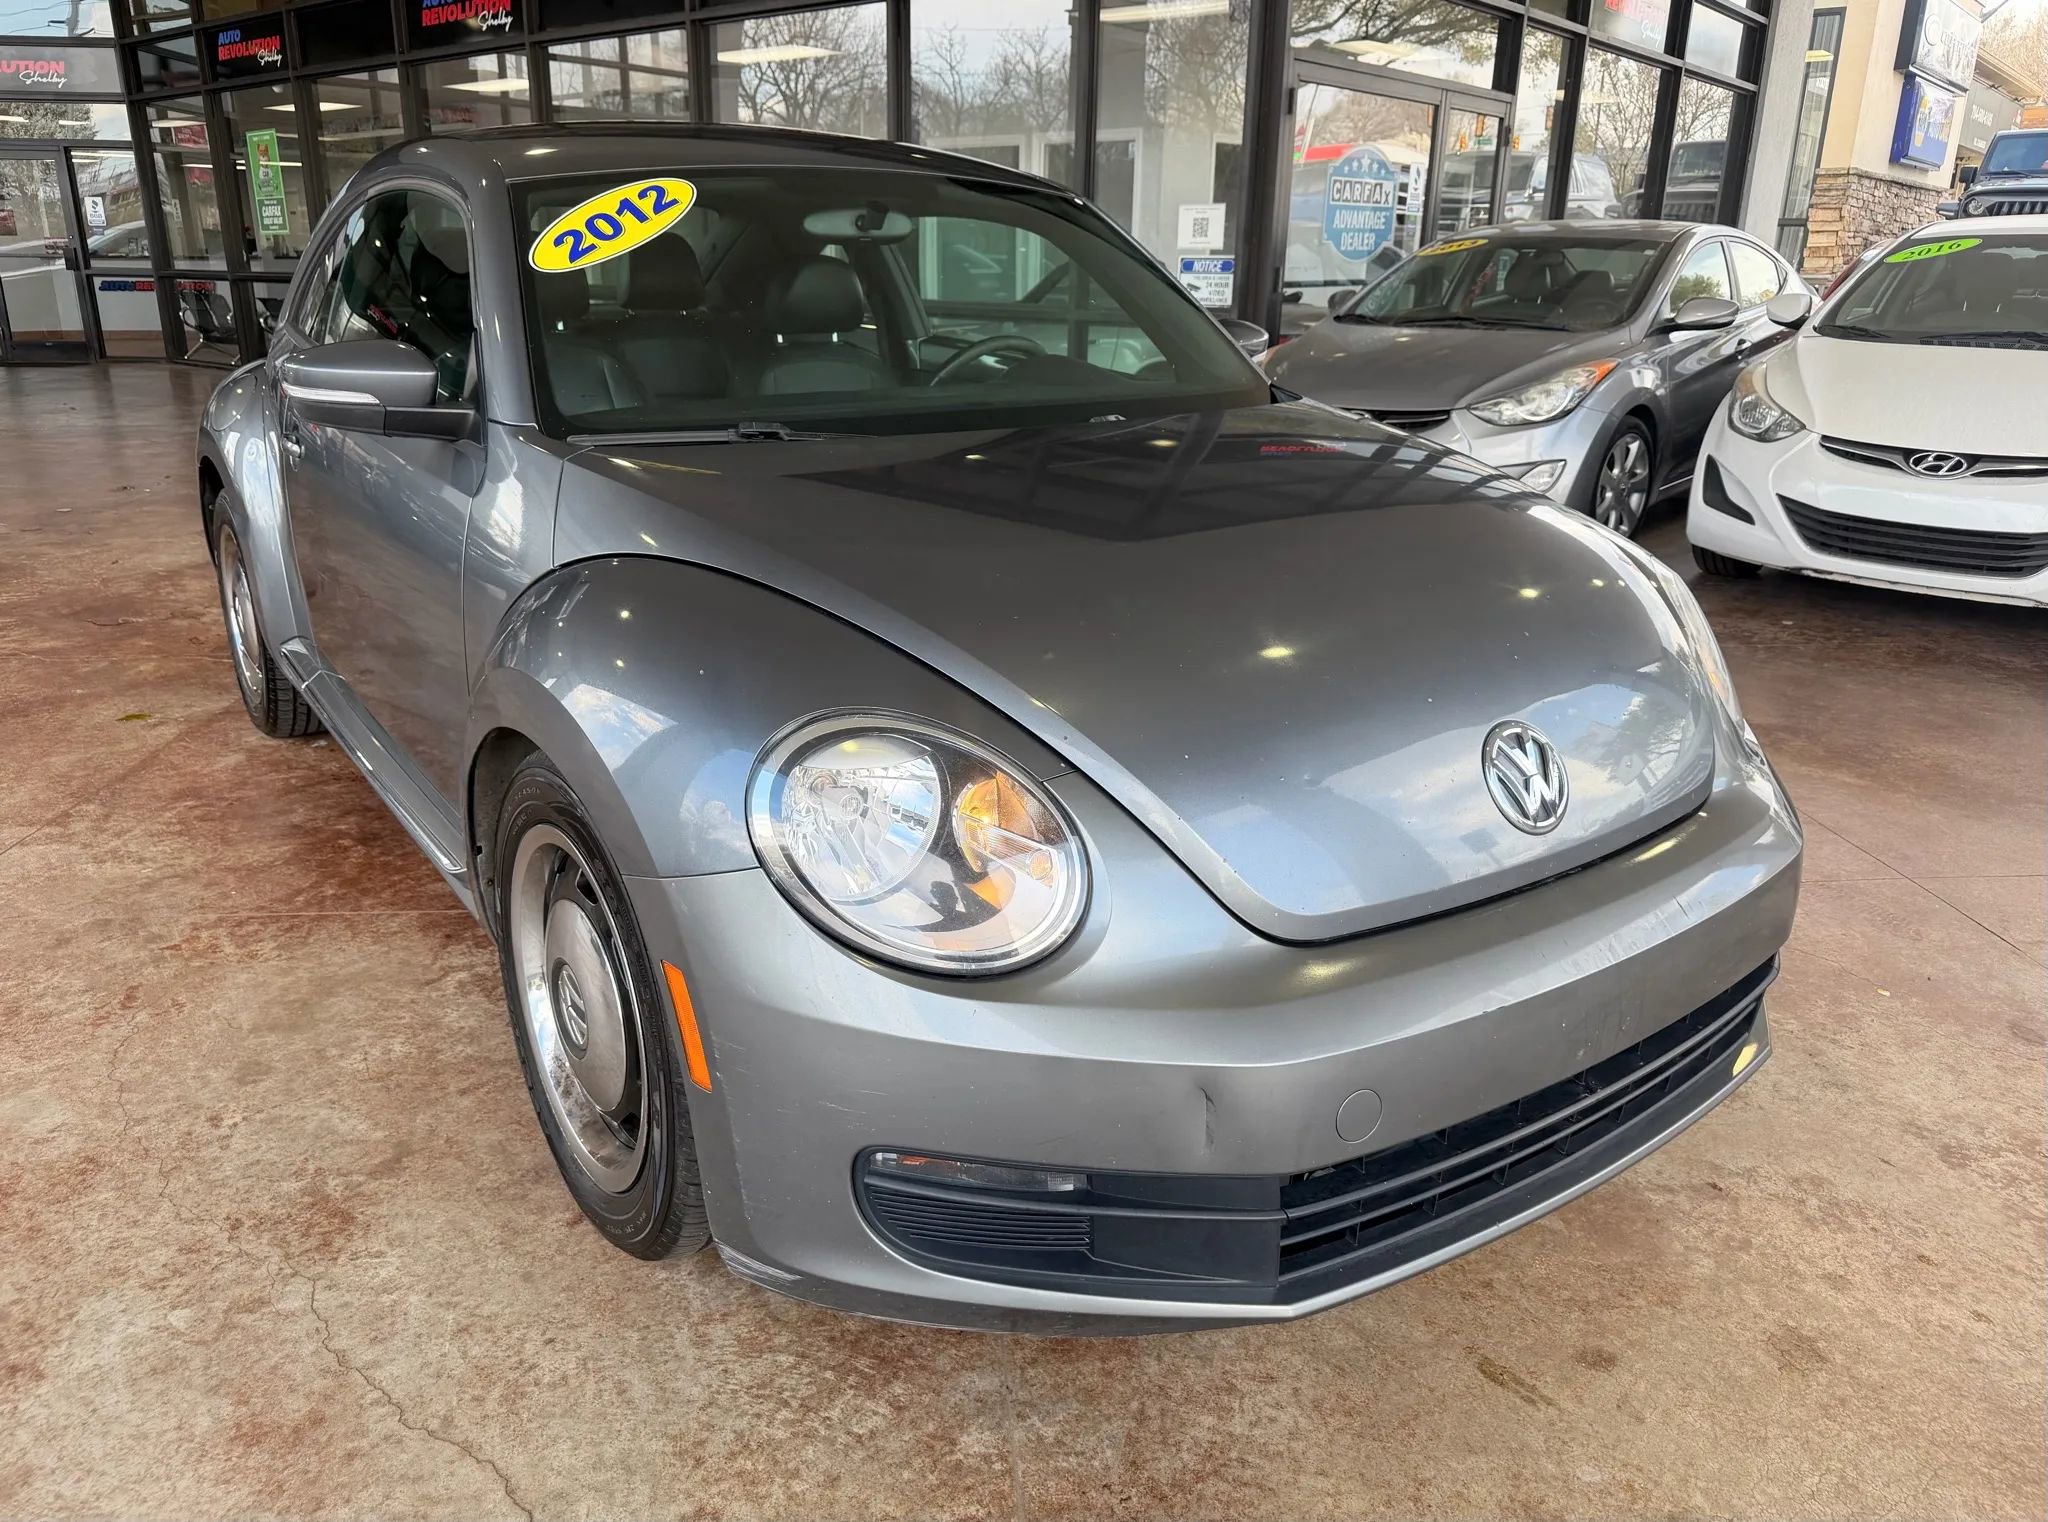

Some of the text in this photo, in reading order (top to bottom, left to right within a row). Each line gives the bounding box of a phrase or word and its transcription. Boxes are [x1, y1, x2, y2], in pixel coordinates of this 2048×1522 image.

[422, 0, 512, 27] REVOLUTION
[477, 6, 513, 32] Shelby
[218, 29, 241, 45] AUTO
[218, 35, 280, 61] REVOLUTION
[0, 60, 65, 74] UTION
[19, 70, 68, 88] Shelby
[1333, 181, 1392, 205] CARFAX
[261, 205, 282, 217] CARFAX
[1333, 209, 1386, 229] ADVANTAGE
[553, 185, 681, 264] 2012
[1340, 231, 1376, 251] DEALER
[1903, 241, 1962, 260] 2016
[1192, 259, 1223, 272] NOTICE
